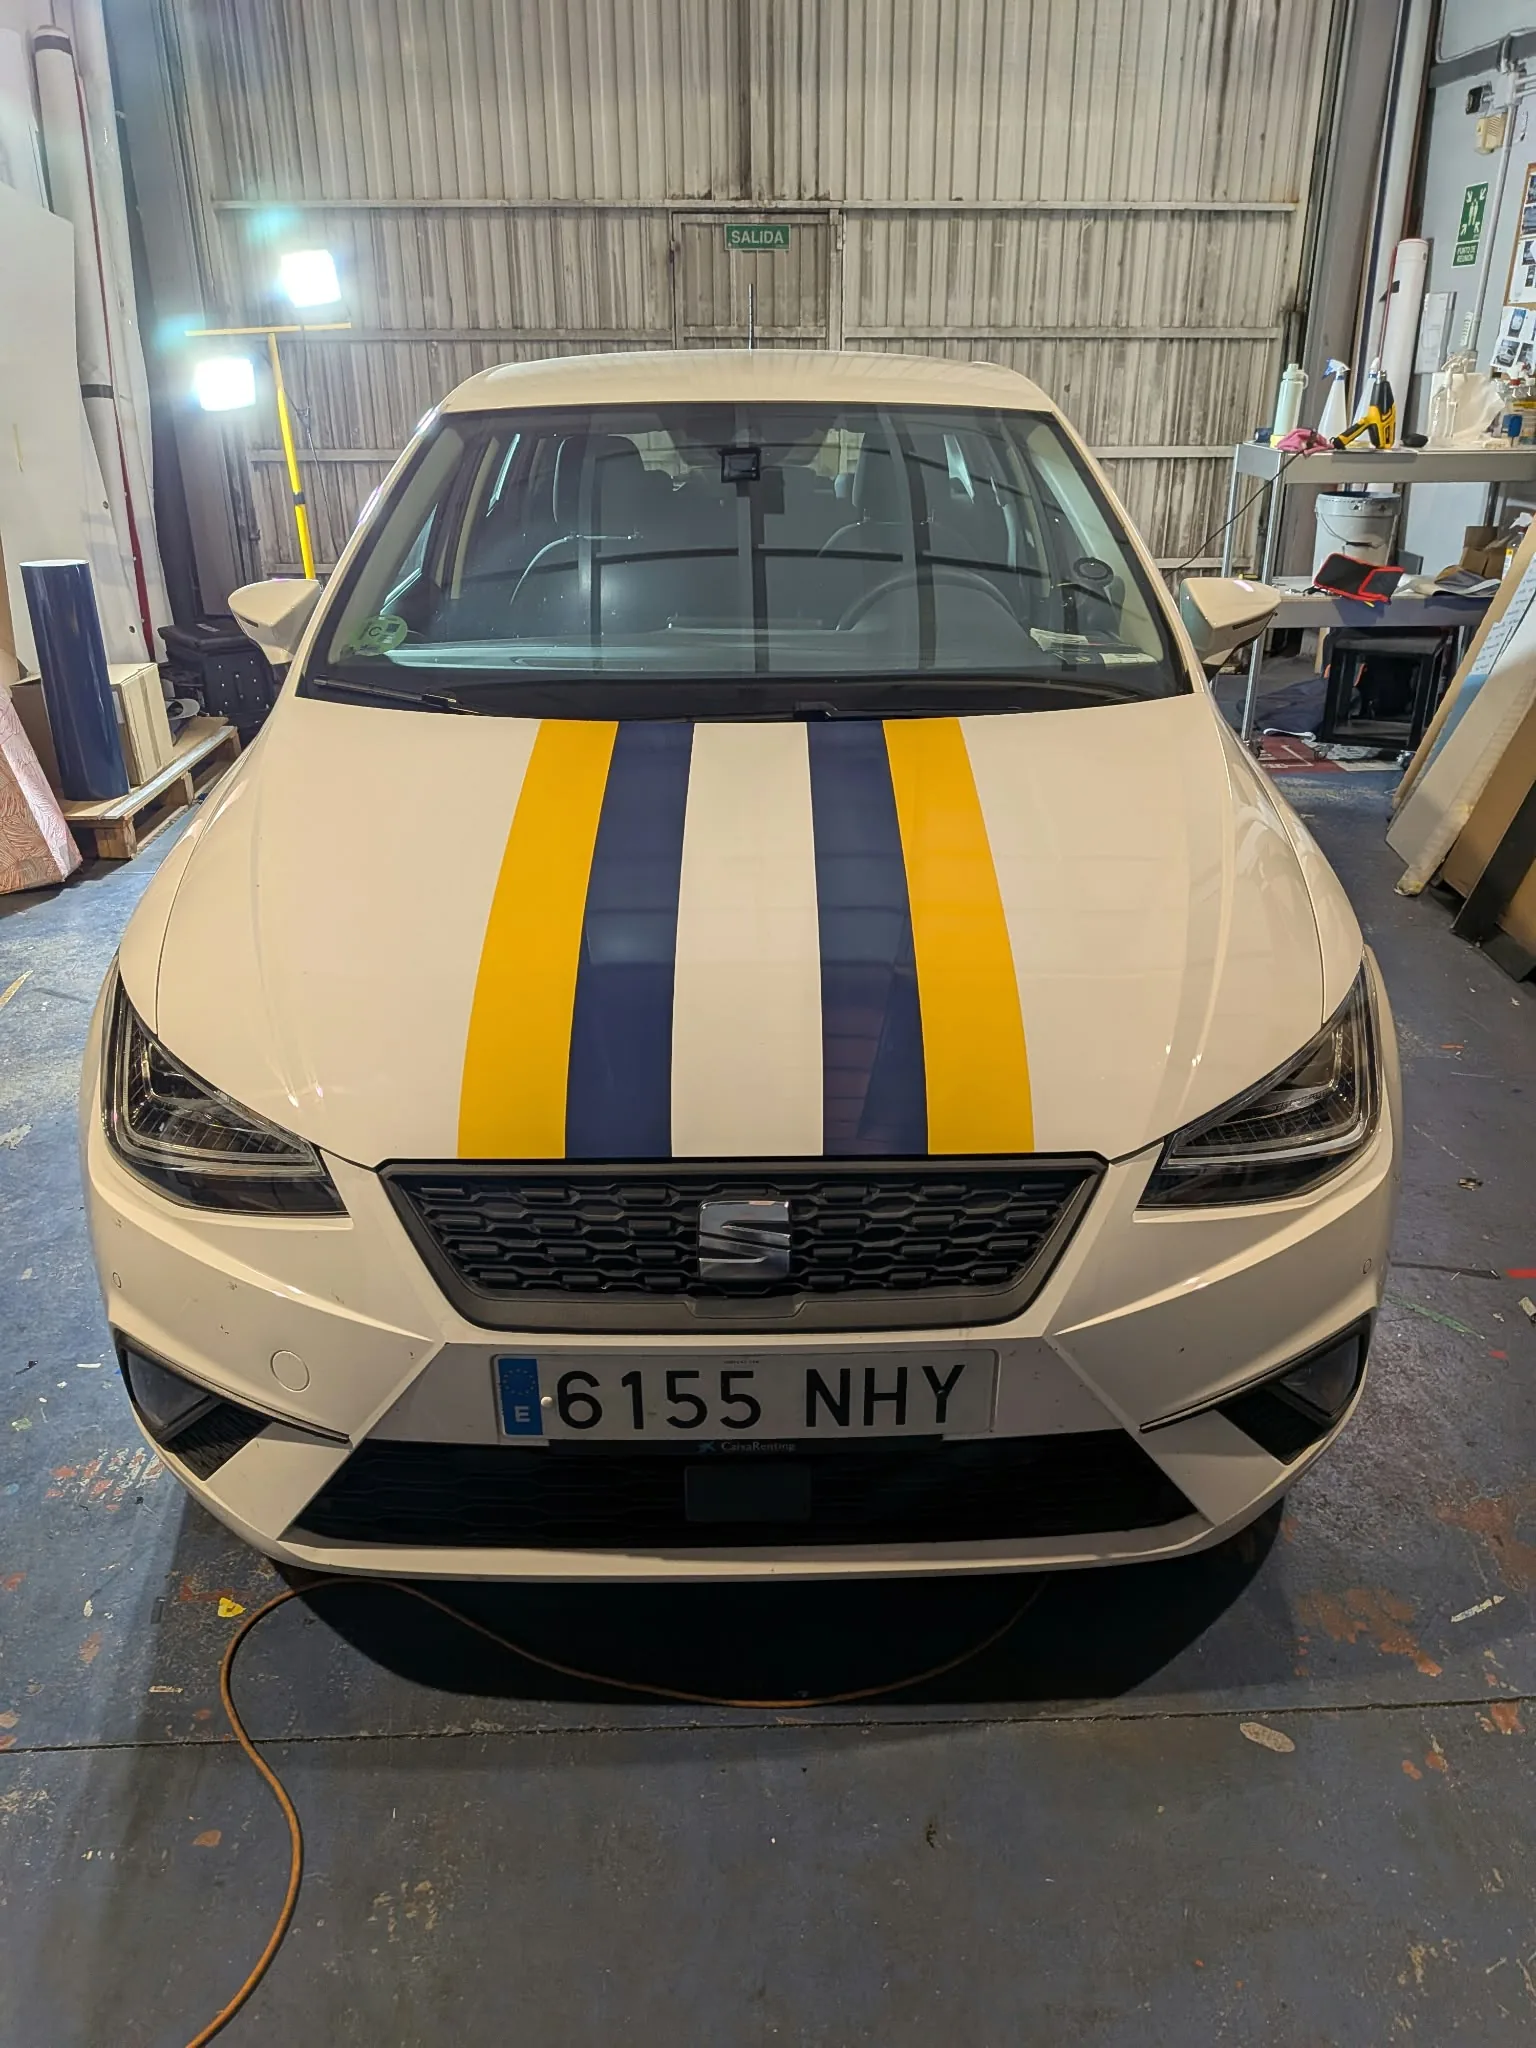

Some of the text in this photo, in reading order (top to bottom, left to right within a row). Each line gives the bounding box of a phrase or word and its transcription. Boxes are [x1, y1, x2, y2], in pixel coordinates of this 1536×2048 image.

[731, 230, 784, 244] SALIDA
[557, 1365, 965, 1430] 6155 NHY
[514, 1406, 530, 1422] E
[721, 1441, 796, 1453] CaixaRenting
